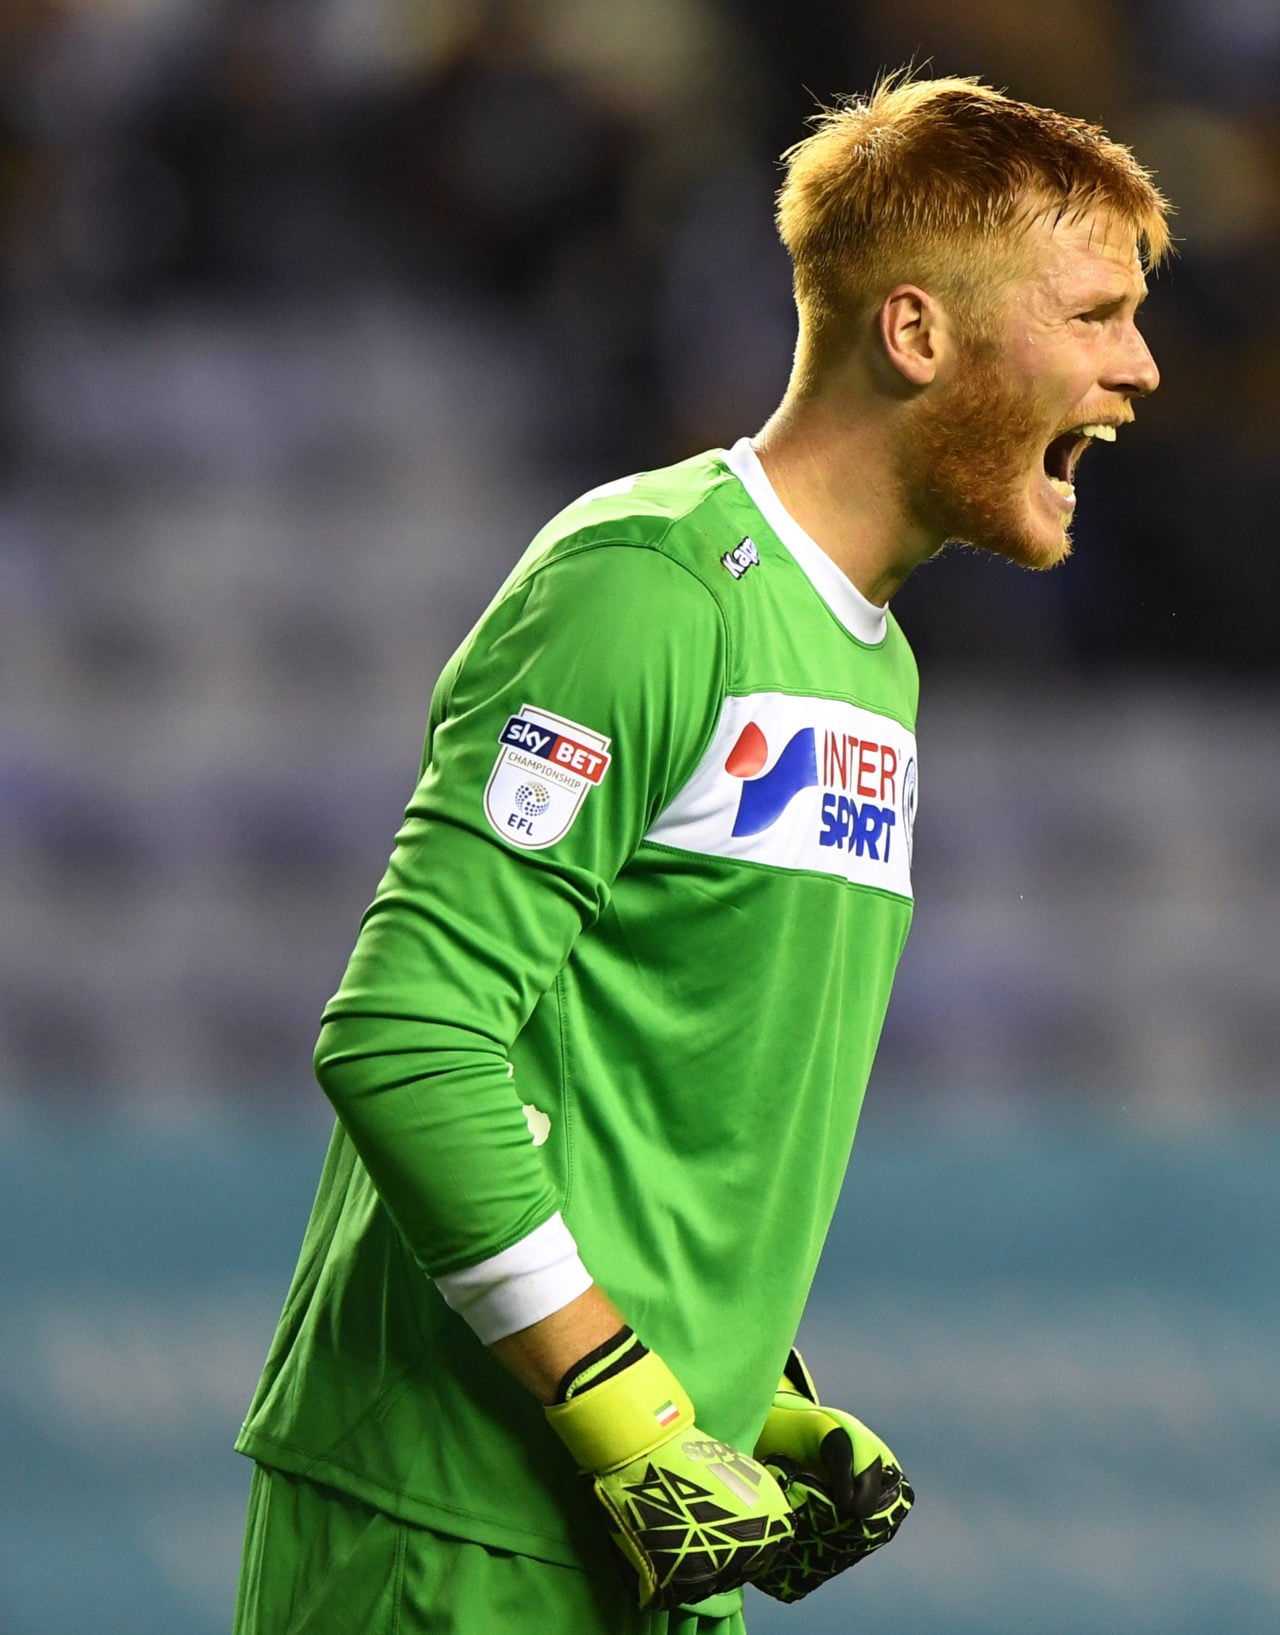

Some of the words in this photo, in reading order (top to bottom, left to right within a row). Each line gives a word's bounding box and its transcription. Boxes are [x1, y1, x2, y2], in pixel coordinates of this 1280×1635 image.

[507, 723, 550, 753] sky
[556, 741, 602, 775] BET
[508, 751, 582, 789] CHAMPIONSHIP
[823, 729, 897, 806] INTER
[507, 813, 533, 836] EFL
